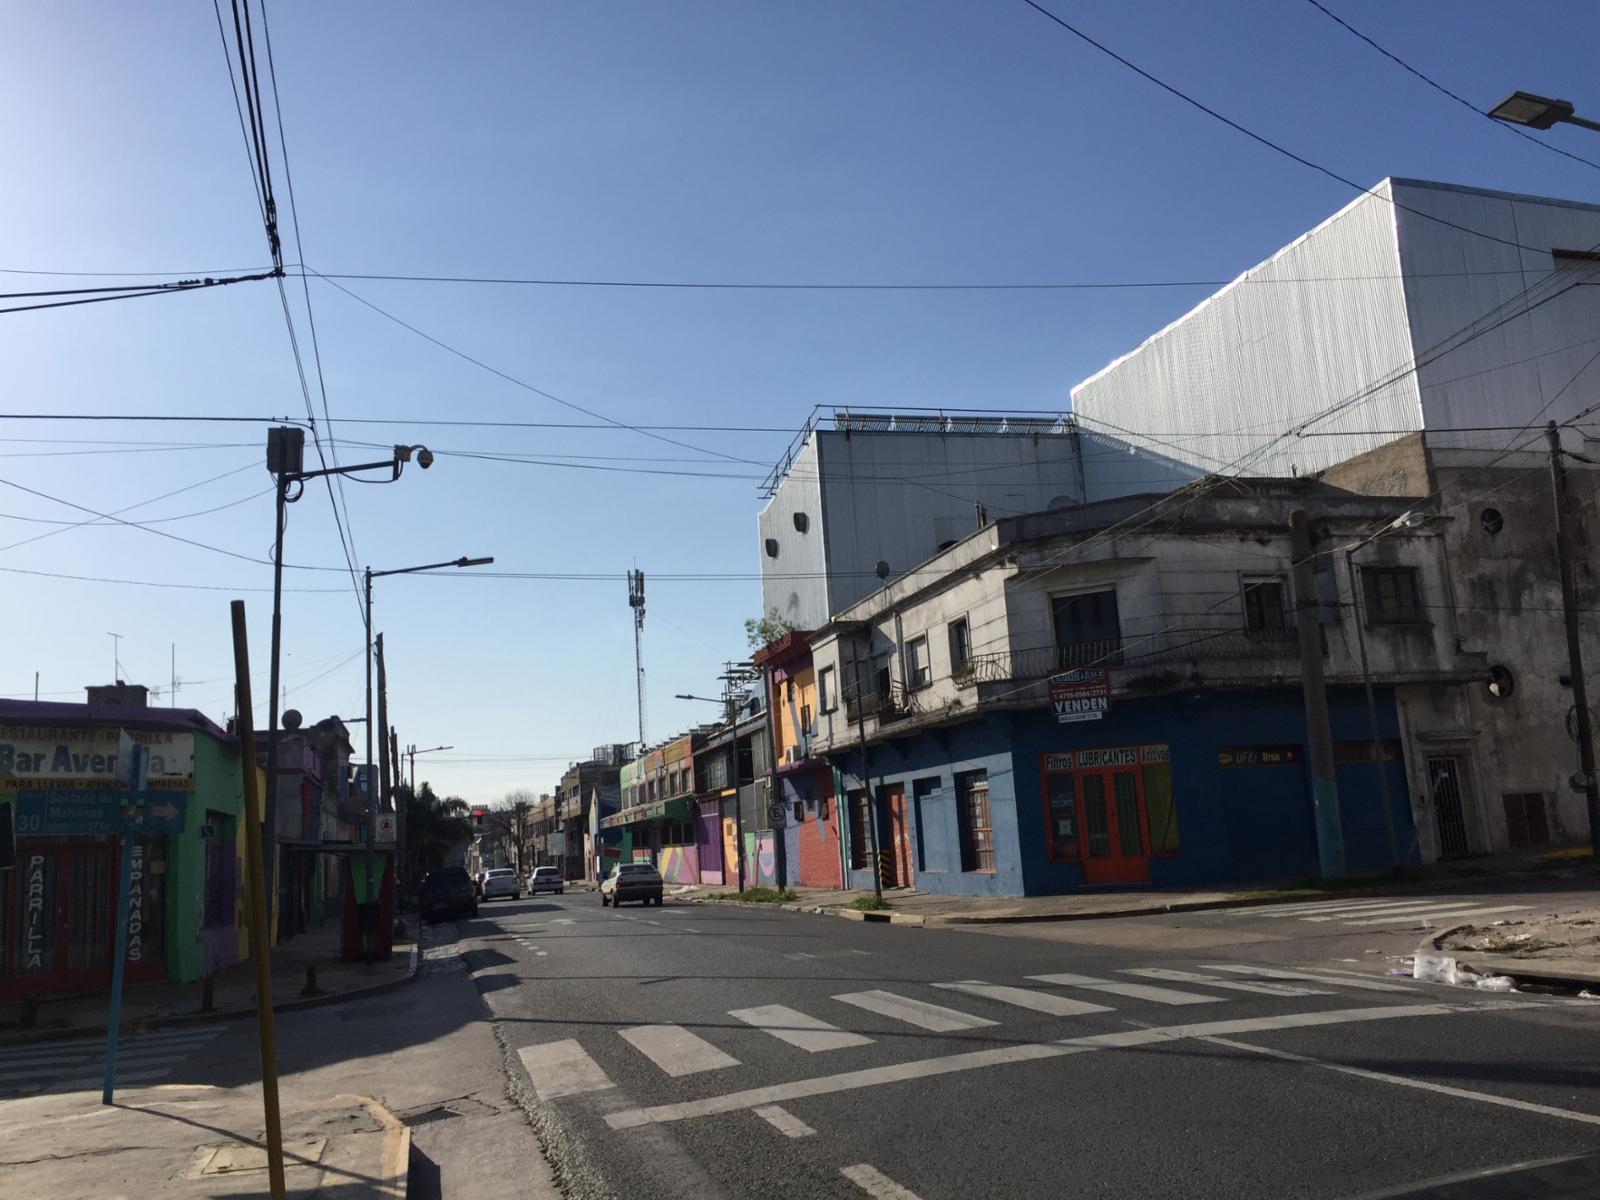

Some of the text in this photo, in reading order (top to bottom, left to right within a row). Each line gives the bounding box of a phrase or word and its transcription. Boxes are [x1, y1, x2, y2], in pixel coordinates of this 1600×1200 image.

[1055, 697, 1107, 714] VENDEN
[0, 727, 96, 742] ESTAURANTE
[0, 744, 166, 773] Bar Avena
[1046, 754, 1072, 769] Filtros
[1078, 748, 1136, 767] LUBRICANTES
[5, 779, 33, 789] PARA
[38, 779, 75, 789] LLEVAR
[50, 806, 104, 818] Malvinas
[17, 814, 41, 832] 30
[27, 855, 45, 968] PARRILLA
[128, 845, 144, 961] EMPANADAS
